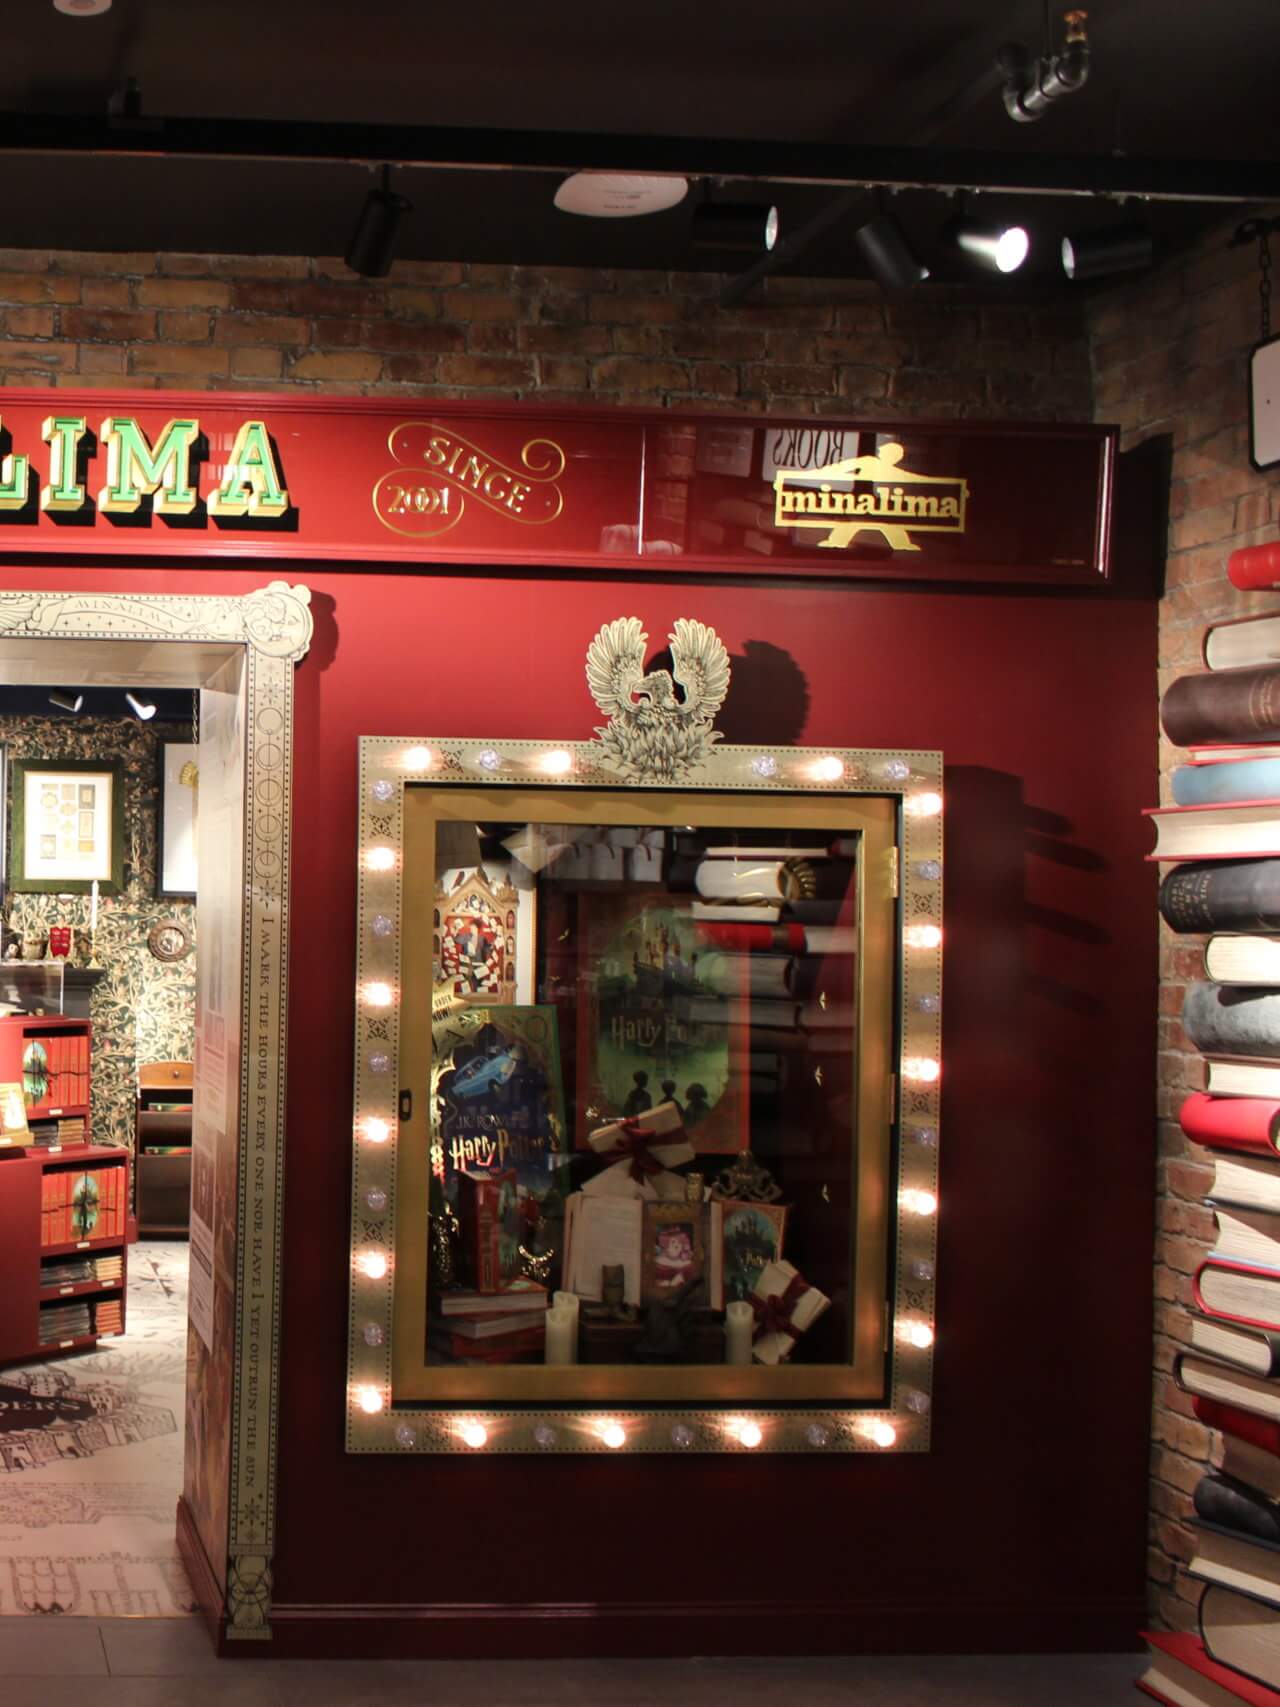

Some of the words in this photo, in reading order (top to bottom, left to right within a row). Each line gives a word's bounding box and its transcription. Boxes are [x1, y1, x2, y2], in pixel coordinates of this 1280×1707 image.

[422, 436, 531, 513] SINCE
[387, 485, 449, 514] 2001
[782, 484, 960, 518] minalima
[75, 599, 175, 629] MINALIMA
[262, 916, 274, 924] I
[260, 929, 270, 987] MARK
[258, 992, 270, 1031] THE
[257, 1034, 269, 1090] HOURS
[255, 1095, 267, 1152] EVERY
[449, 1134, 496, 1172] Harry
[254, 1156, 265, 1192] ONE
[253, 1197, 264, 1232] NOR
[252, 1238, 264, 1288] HAVE
[251, 1292, 264, 1300] I
[250, 1305, 261, 1338] YET
[248, 1342, 260, 1411] OUTRUN
[246, 1414, 258, 1450] THE
[245, 1455, 257, 1489] SUN
